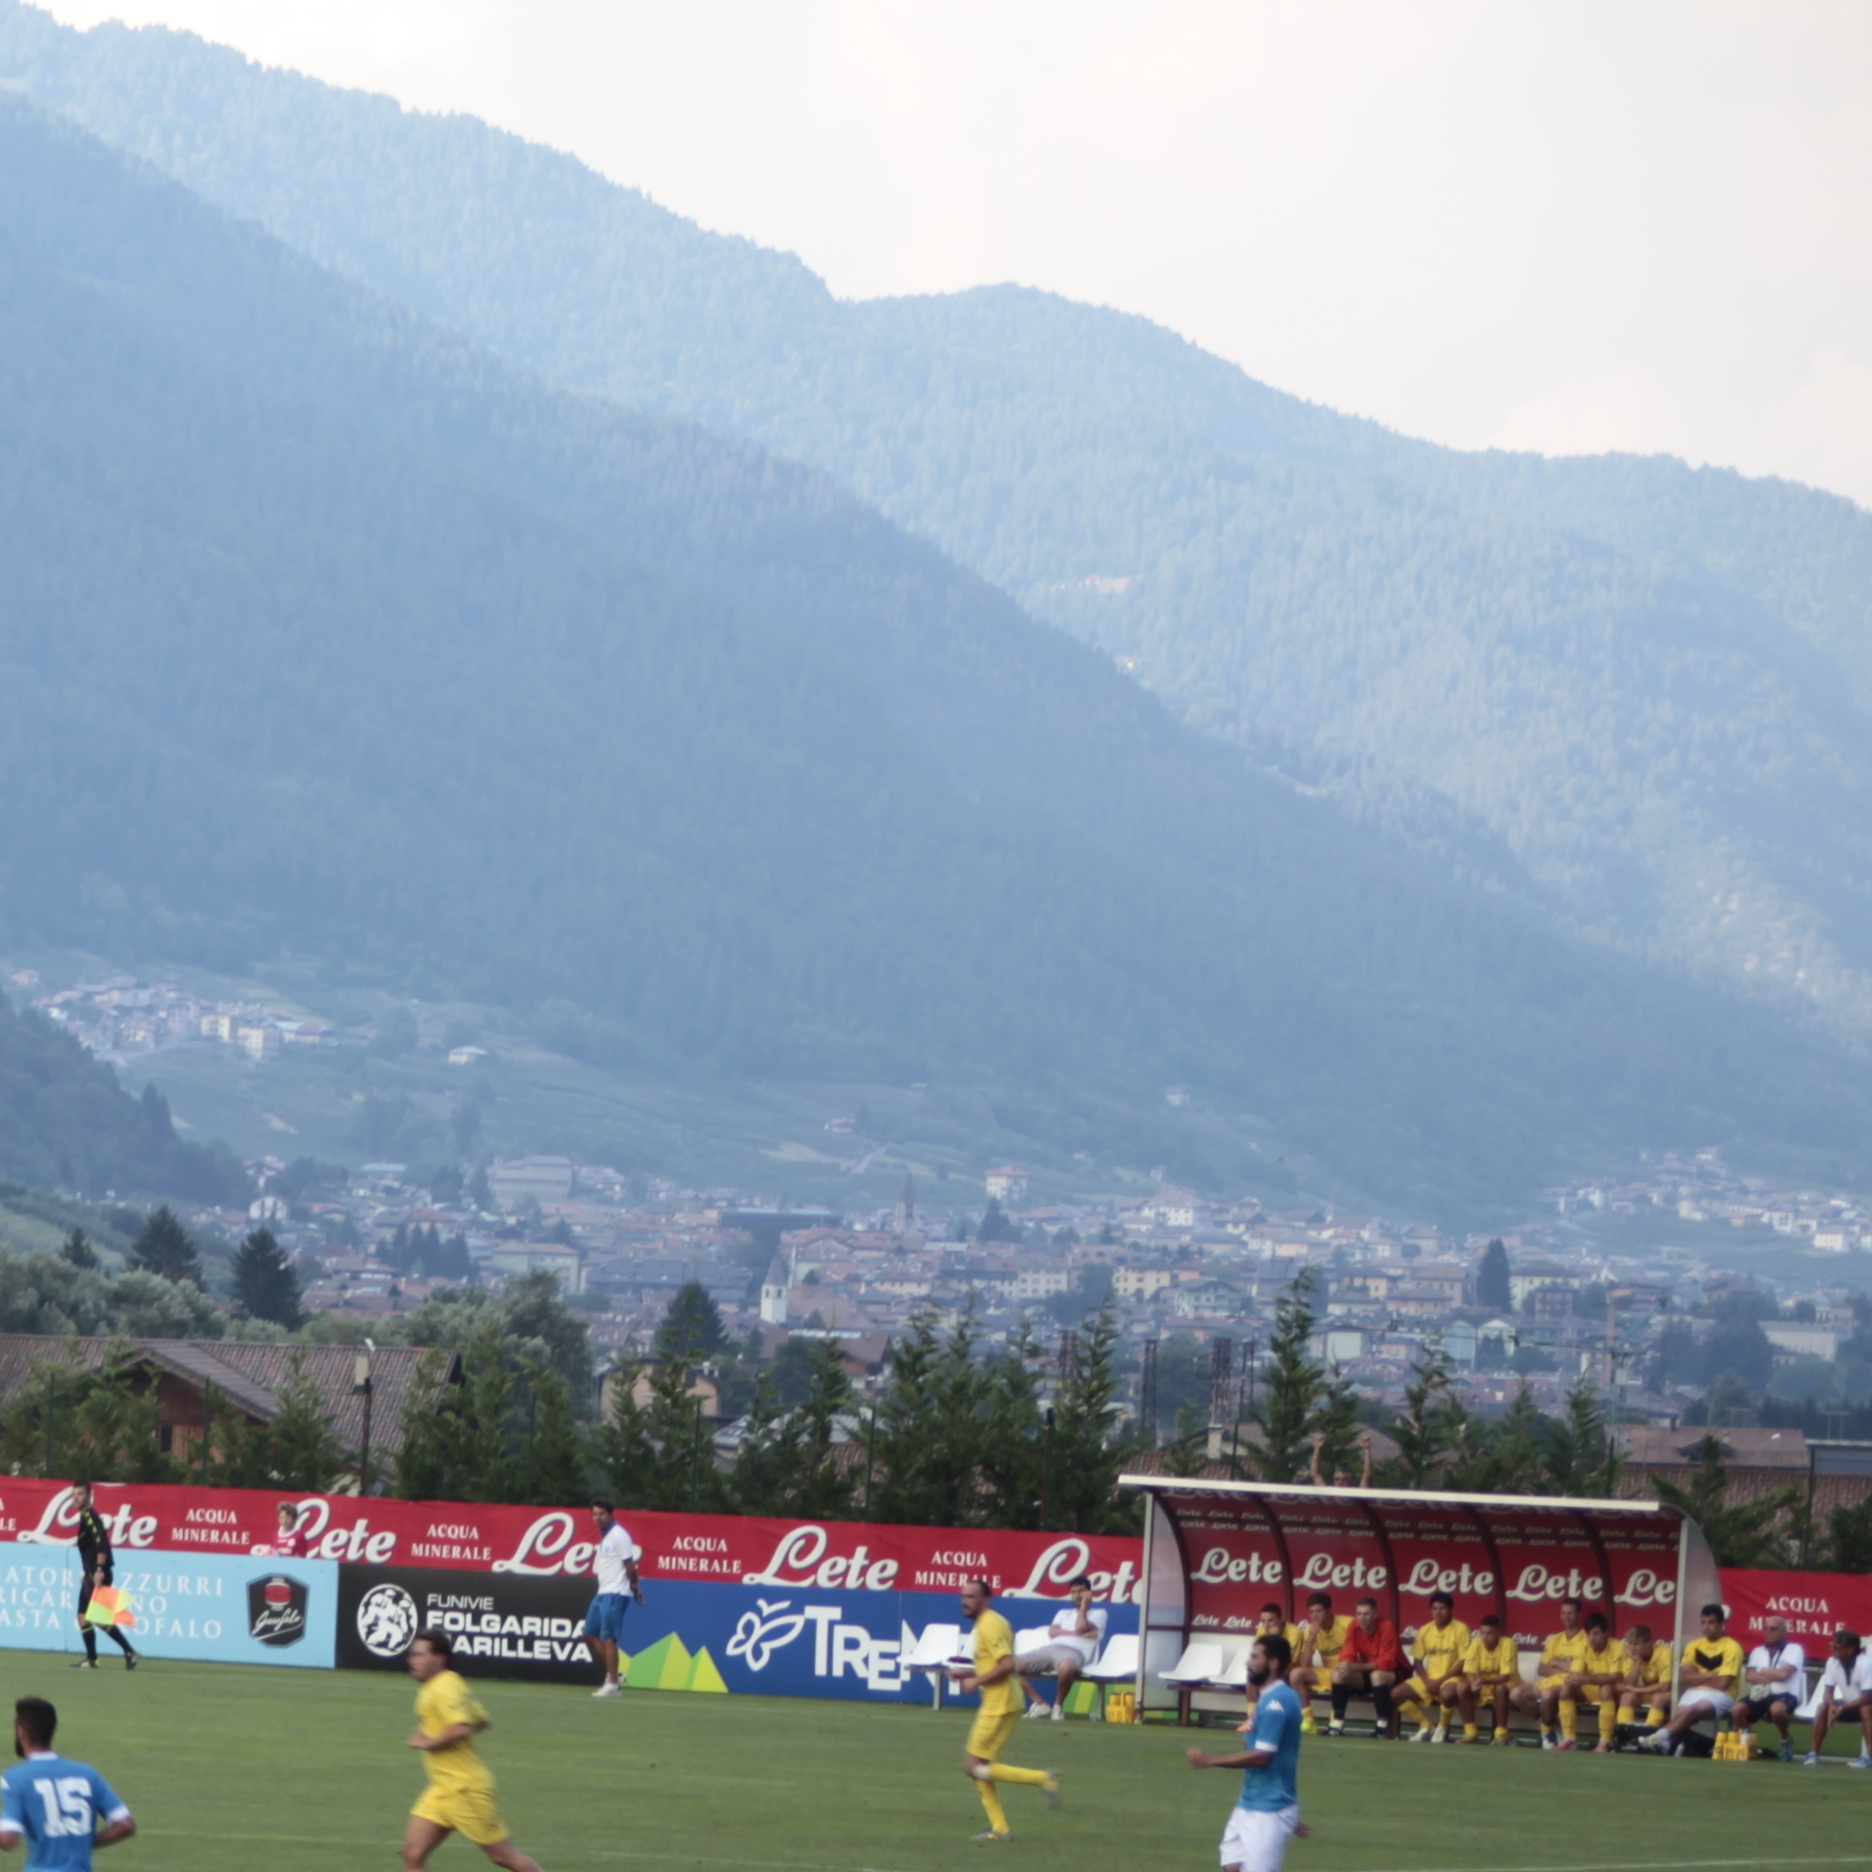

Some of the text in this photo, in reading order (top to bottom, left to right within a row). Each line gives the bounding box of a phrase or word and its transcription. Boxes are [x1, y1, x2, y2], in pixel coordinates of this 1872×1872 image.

[17, 1486, 157, 1547] Lte
[186, 1508, 237, 1524] ACQUA
[171, 1528, 250, 1544] MINERALE
[427, 1524, 479, 1539] ACQUA
[411, 1543, 492, 1560] MINERALE
[673, 1536, 728, 1552] ACQUA
[658, 1556, 742, 1573] MINERALE
[742, 1525, 899, 1590] Lete
[932, 1550, 987, 1567] ACQUA
[1190, 1547, 1282, 1584] Lete
[1292, 1553, 1387, 1589] Lete
[1398, 1559, 1494, 1595] Lete
[119, 1572, 224, 1596] ZZURRI
[1506, 1565, 1603, 1601] Lete
[426, 1593, 494, 1610] FUNIVIE
[1765, 1597, 1829, 1613] ACQUA
[447, 1635, 593, 1662] ARILLEVA
[33, 1776, 93, 1838] 15
